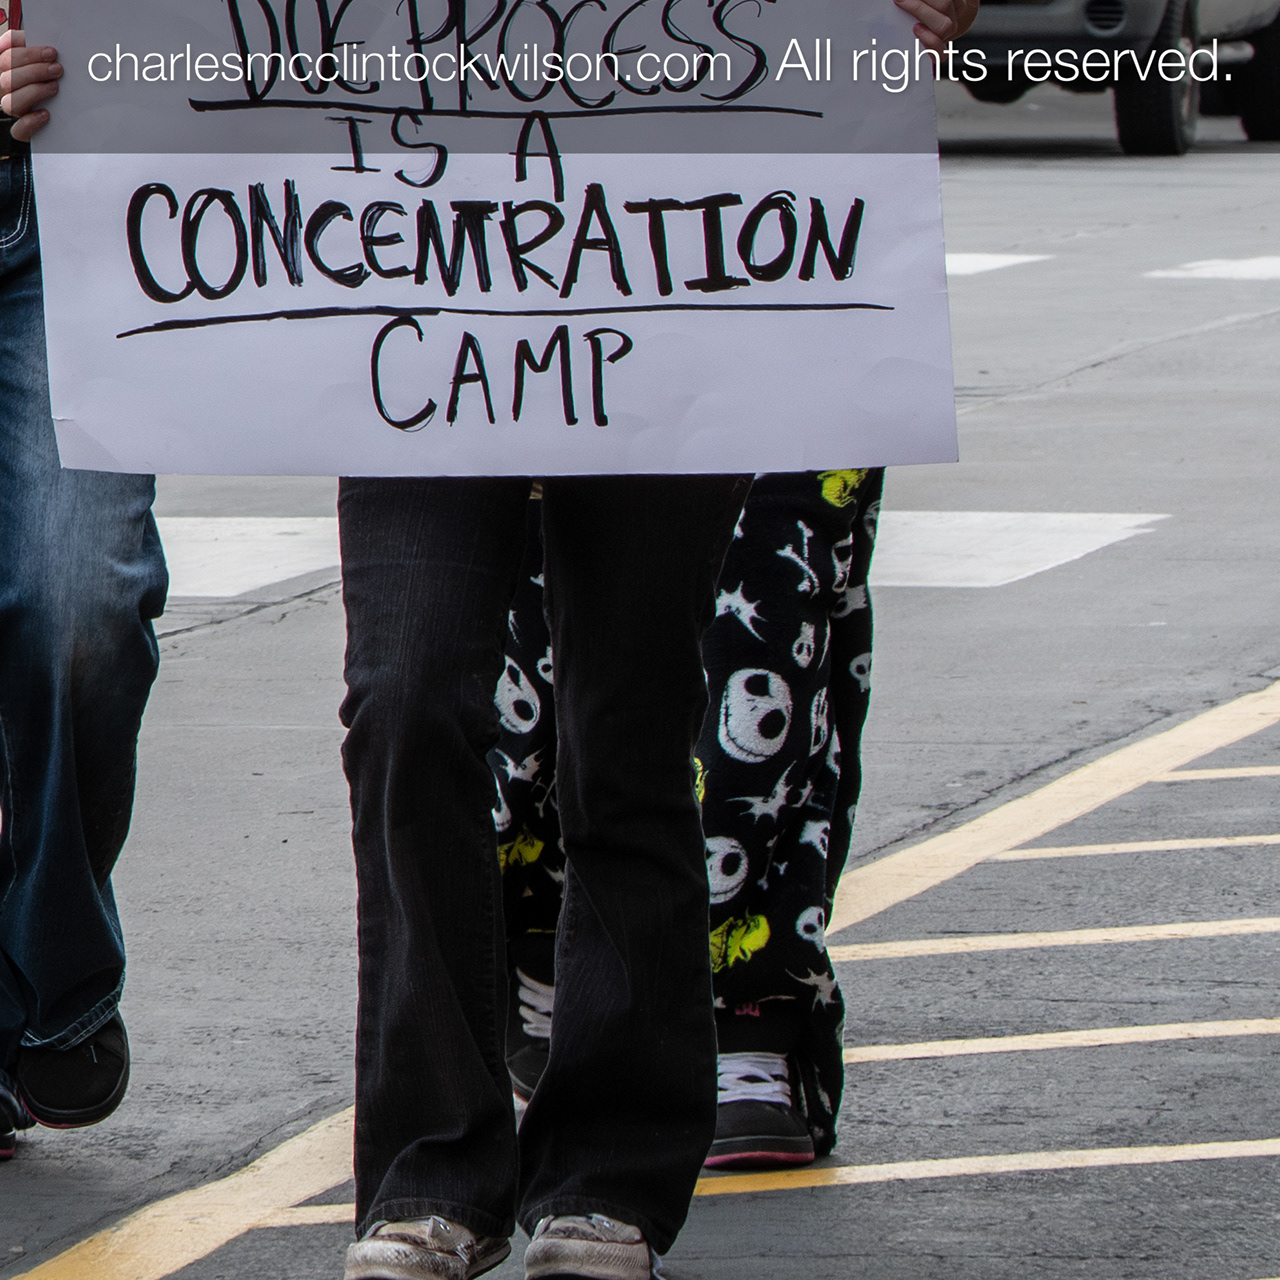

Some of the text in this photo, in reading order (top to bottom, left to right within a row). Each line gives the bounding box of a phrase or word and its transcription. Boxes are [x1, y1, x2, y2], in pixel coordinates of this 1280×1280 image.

[325, 108, 567, 203] IS A
[126, 180, 864, 305] CONCENTRATION
[369, 315, 633, 432] CAMP
